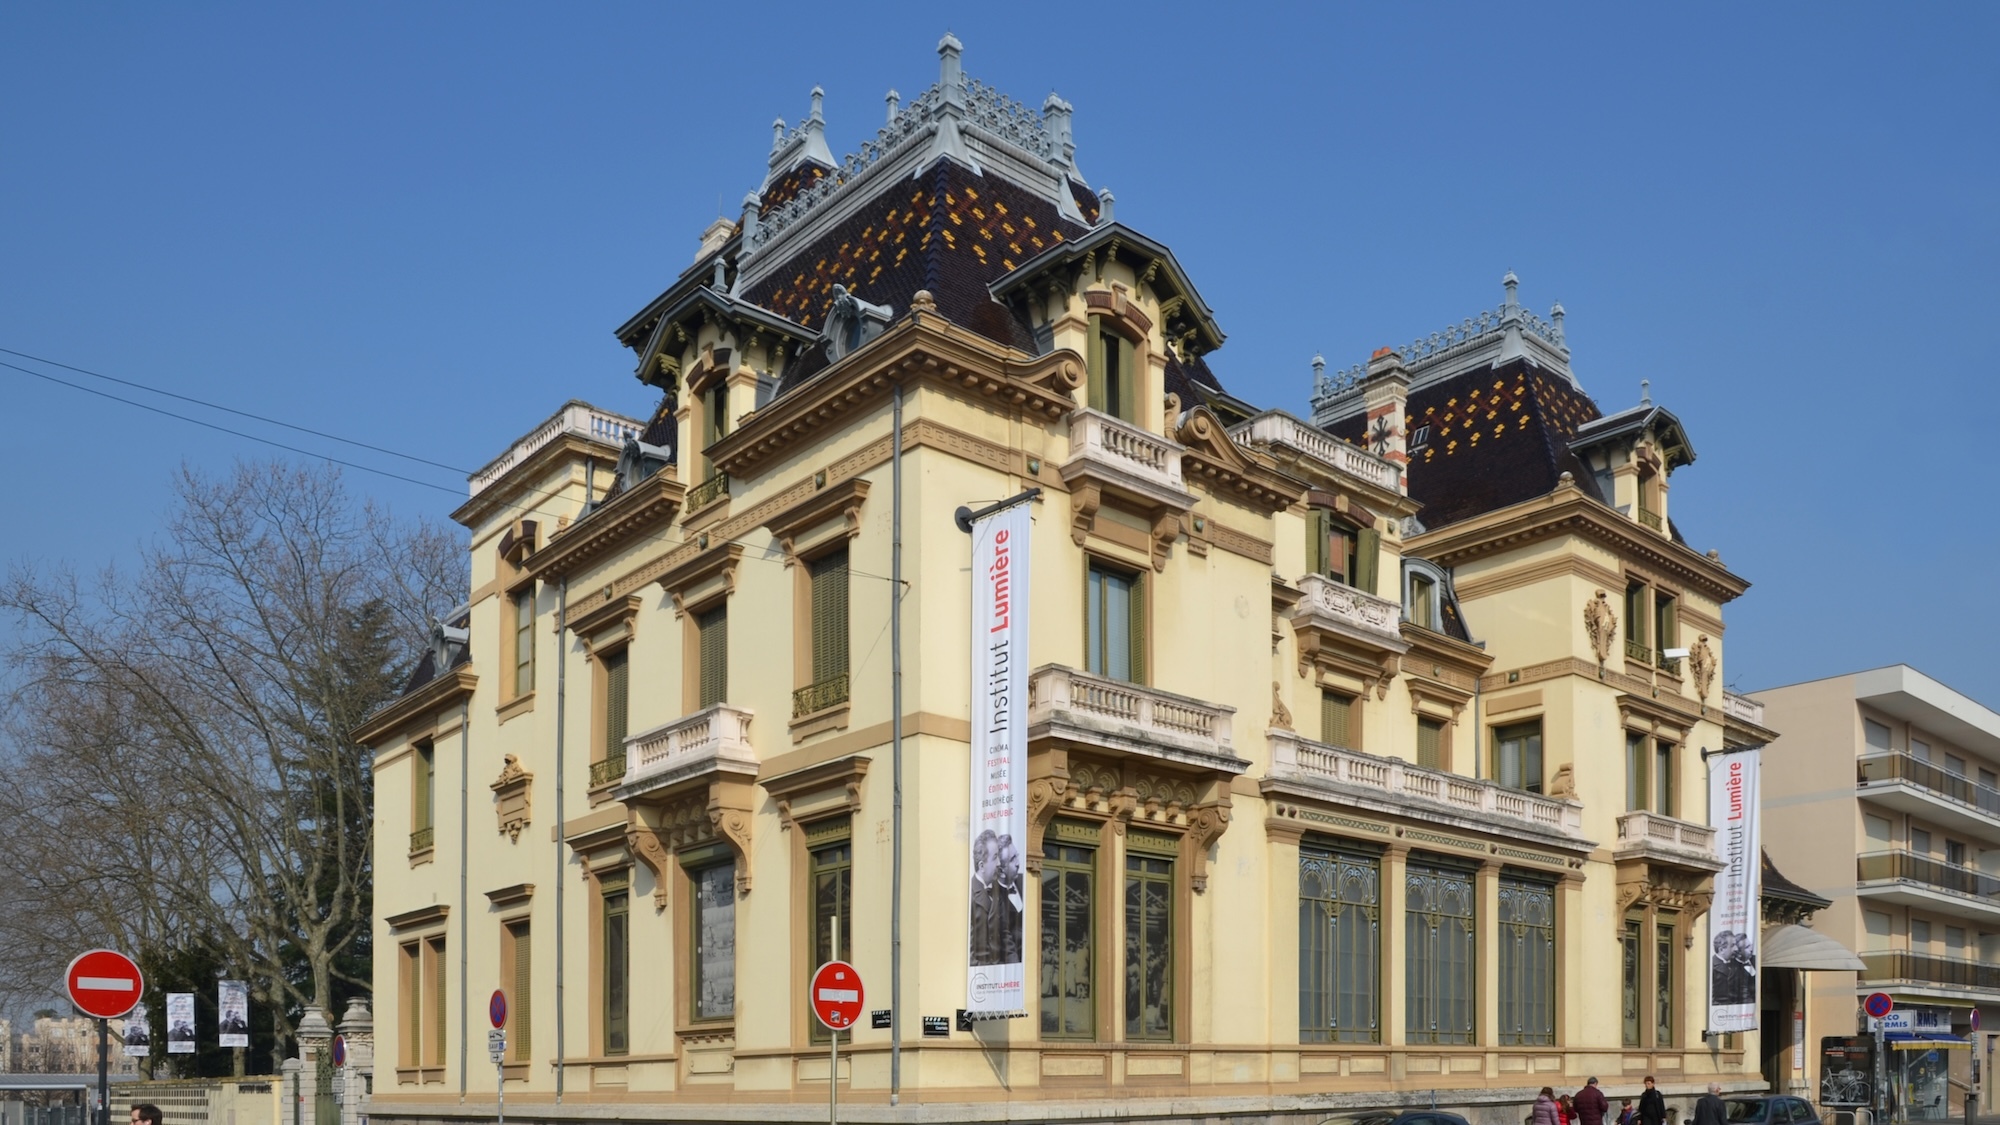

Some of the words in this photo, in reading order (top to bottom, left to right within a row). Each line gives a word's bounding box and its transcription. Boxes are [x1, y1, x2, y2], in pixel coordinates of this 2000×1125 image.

[989, 529, 1009, 634] Lumière
[989, 639, 1009, 734] Institut
[987, 756, 1011, 767] FESTIVAL
[989, 743, 1009, 754] CINÉMA
[988, 782, 1009, 793] ÉDITION
[990, 768, 1007, 780] MUSÉE
[1726, 762, 1743, 821] Lumière
[1727, 824, 1743, 878] Institut
